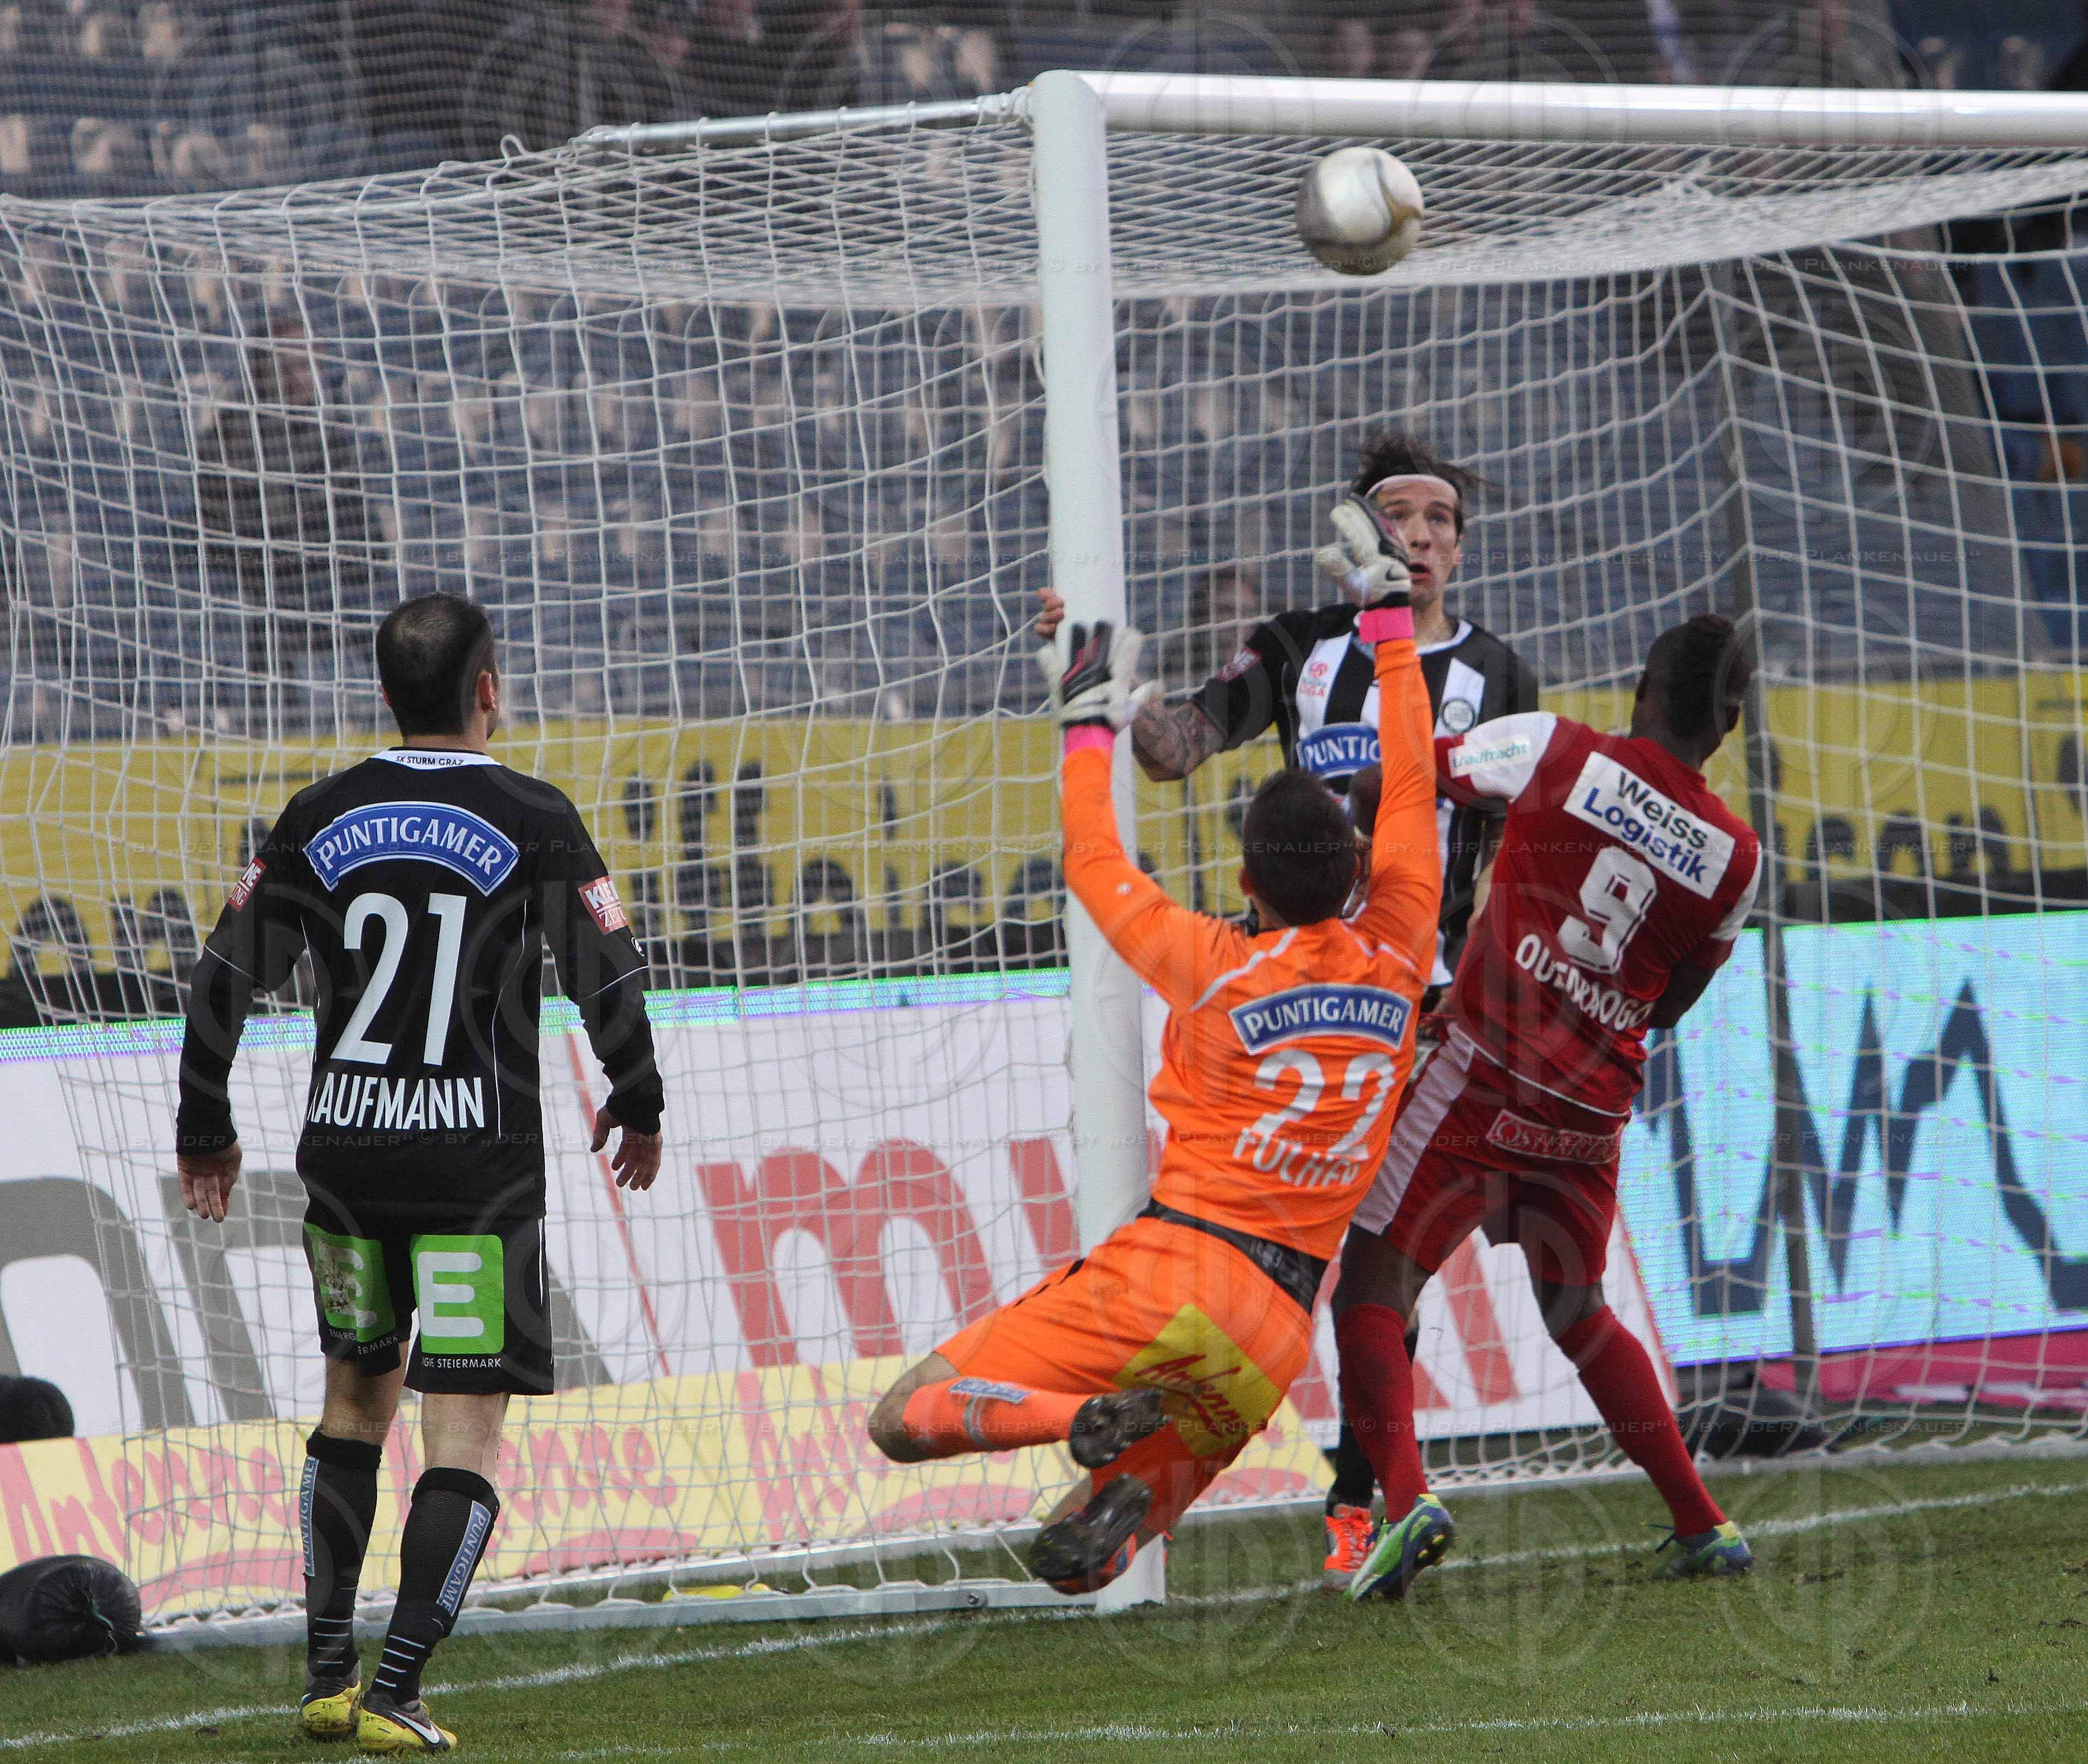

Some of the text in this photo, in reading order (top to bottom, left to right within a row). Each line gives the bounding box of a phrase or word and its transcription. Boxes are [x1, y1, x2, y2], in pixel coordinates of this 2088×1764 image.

[407, 756, 435, 765] STURM
[316, 817, 502, 875] PUNTIGAMER
[1583, 787, 1707, 883] Logistik
[1617, 771, 1708, 848] Weiss
[1557, 845, 1658, 974] 9
[330, 892, 467, 1066] 21
[1243, 997, 1402, 1039] PUNTIGAMER
[307, 1072, 484, 1129] AUFMANN
[1252, 1049, 1396, 1161] 22
[417, 1252, 484, 1337] E
[437, 1358, 501, 1369] STEIERMARK
[442, 1510, 487, 1612] PUNTIGAME
